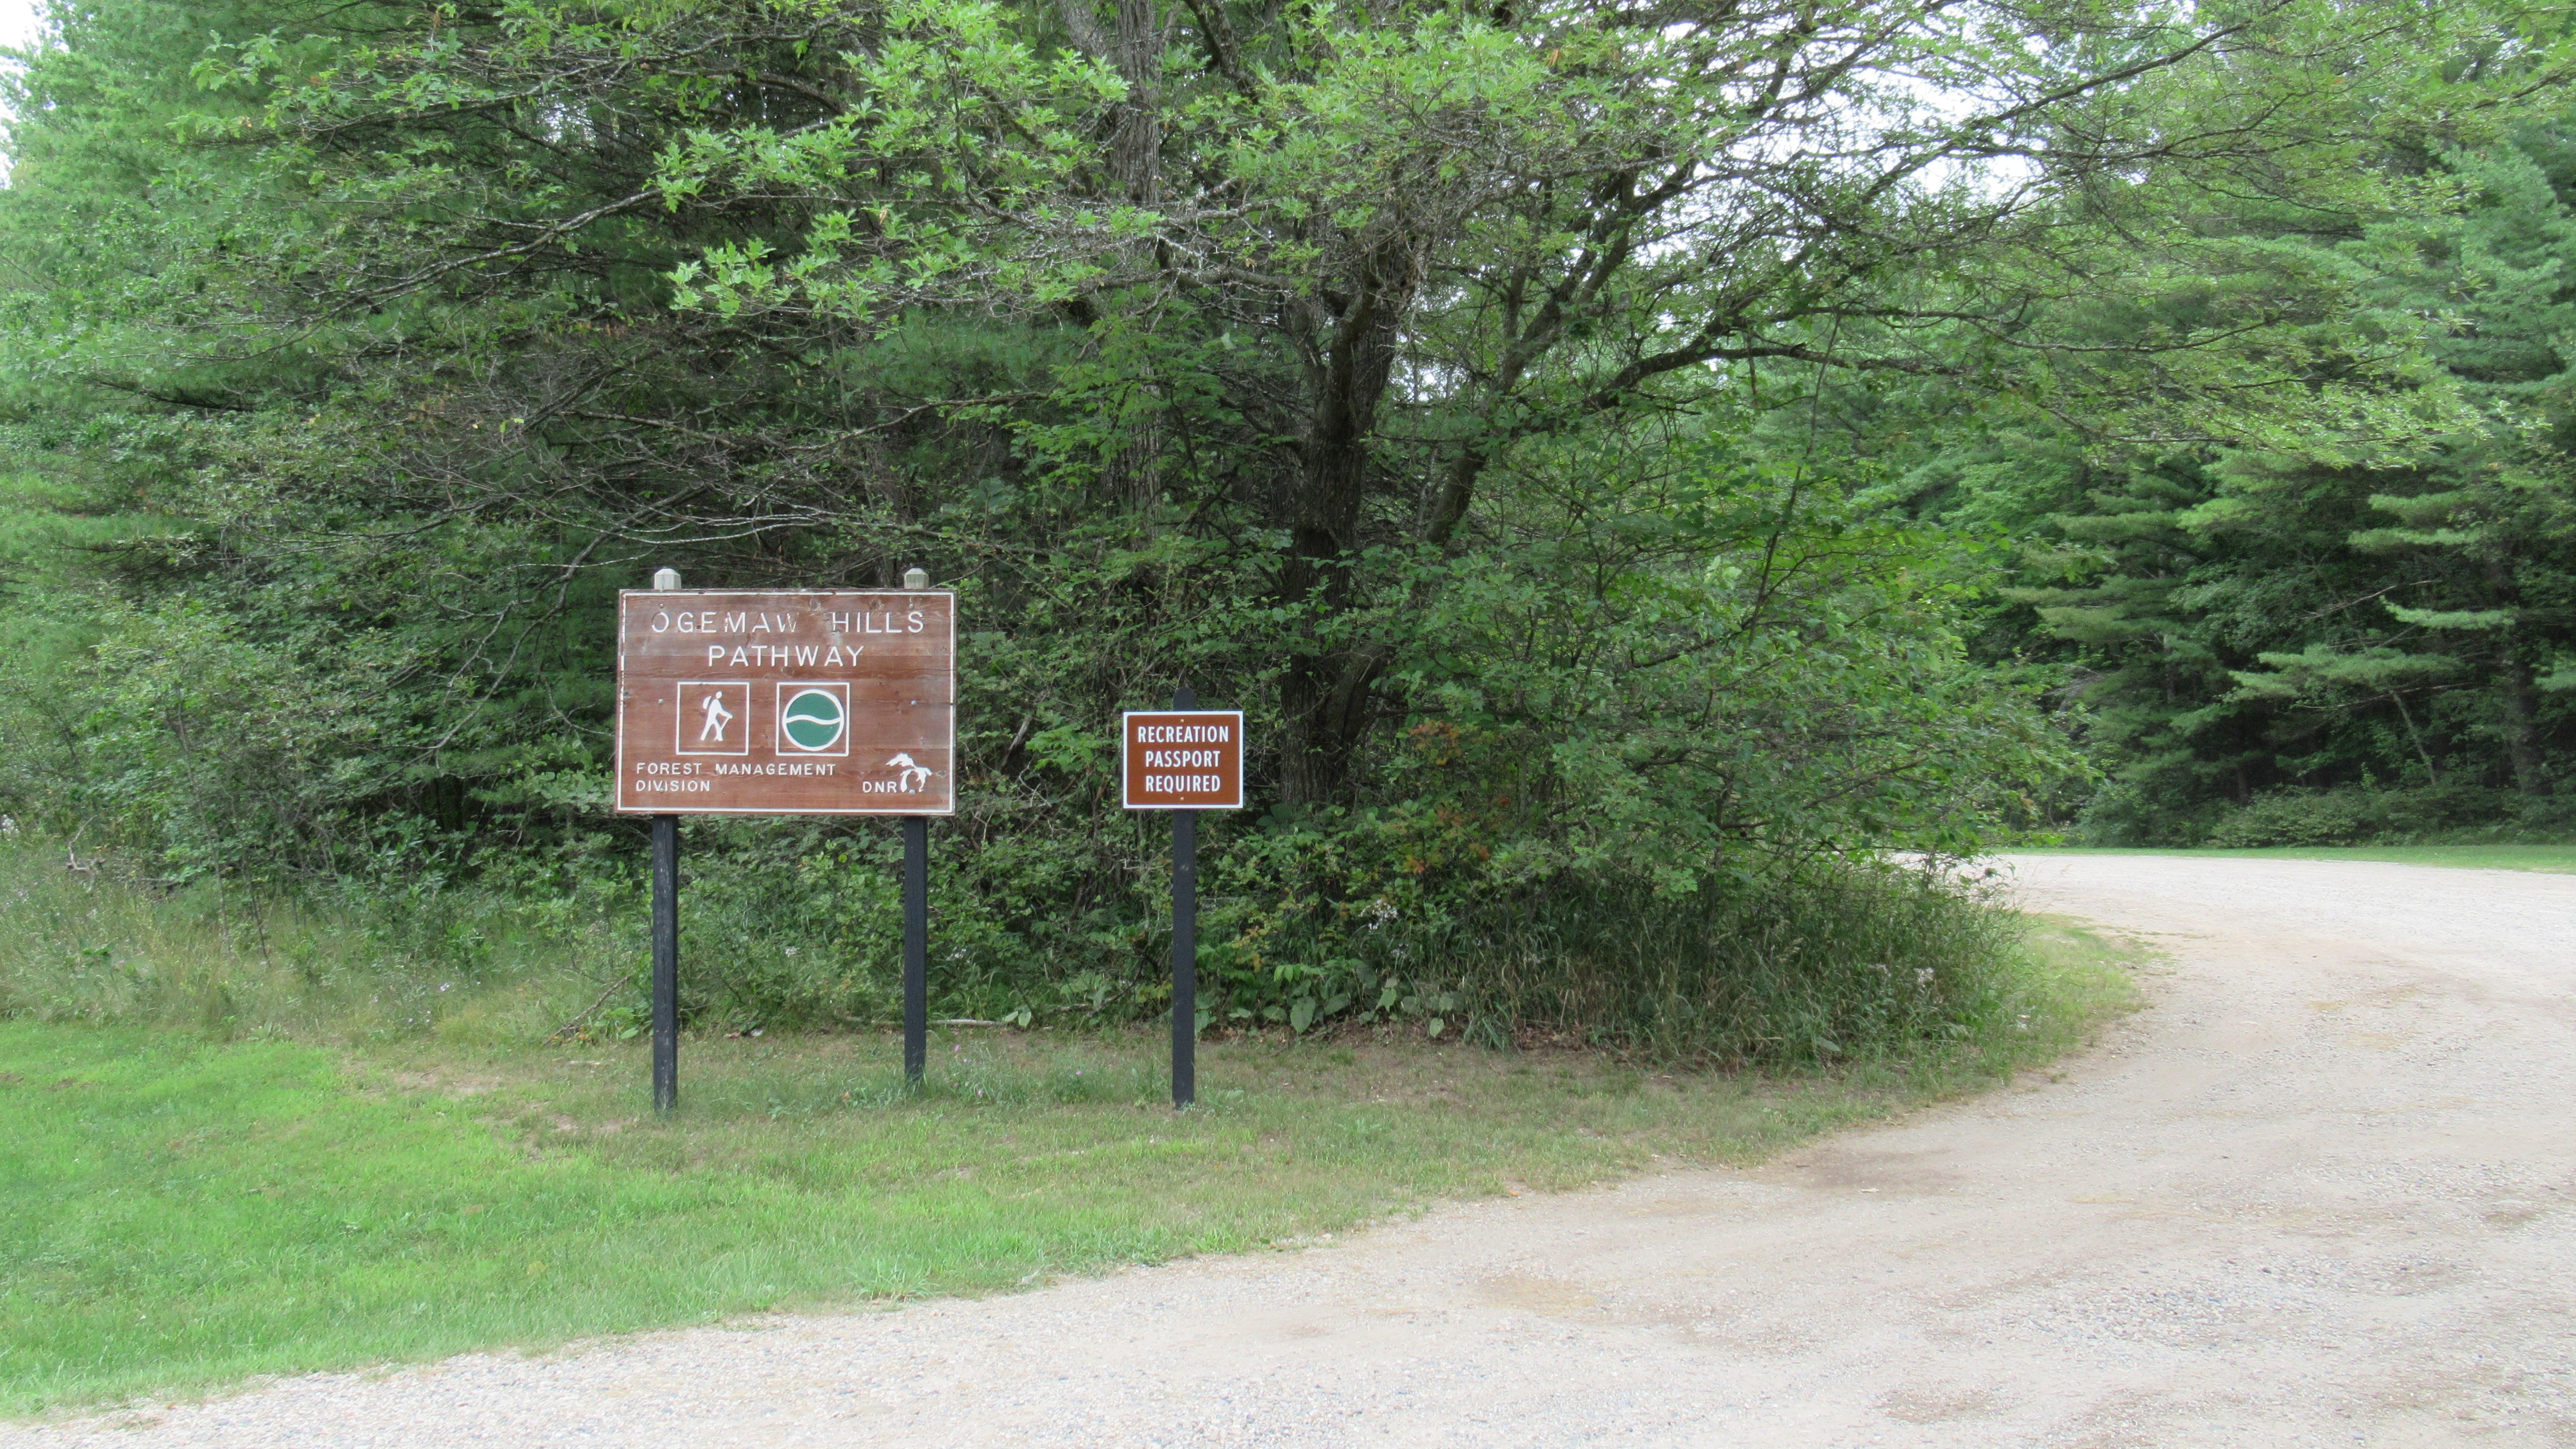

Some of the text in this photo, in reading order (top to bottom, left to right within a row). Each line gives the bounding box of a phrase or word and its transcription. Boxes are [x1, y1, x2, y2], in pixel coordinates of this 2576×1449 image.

[652, 611, 924, 634] OGEMAW HILLS
[709, 645, 864, 667] PATHWAY
[1138, 726, 1229, 743] RECREATION
[1146, 750, 1221, 767] PASSPORT
[636, 762, 835, 776] FOREST MANAGEMENT
[636, 780, 710, 792] DIVISION
[862, 781, 898, 793] DNR
[1146, 775, 1221, 794] REQUIRED
